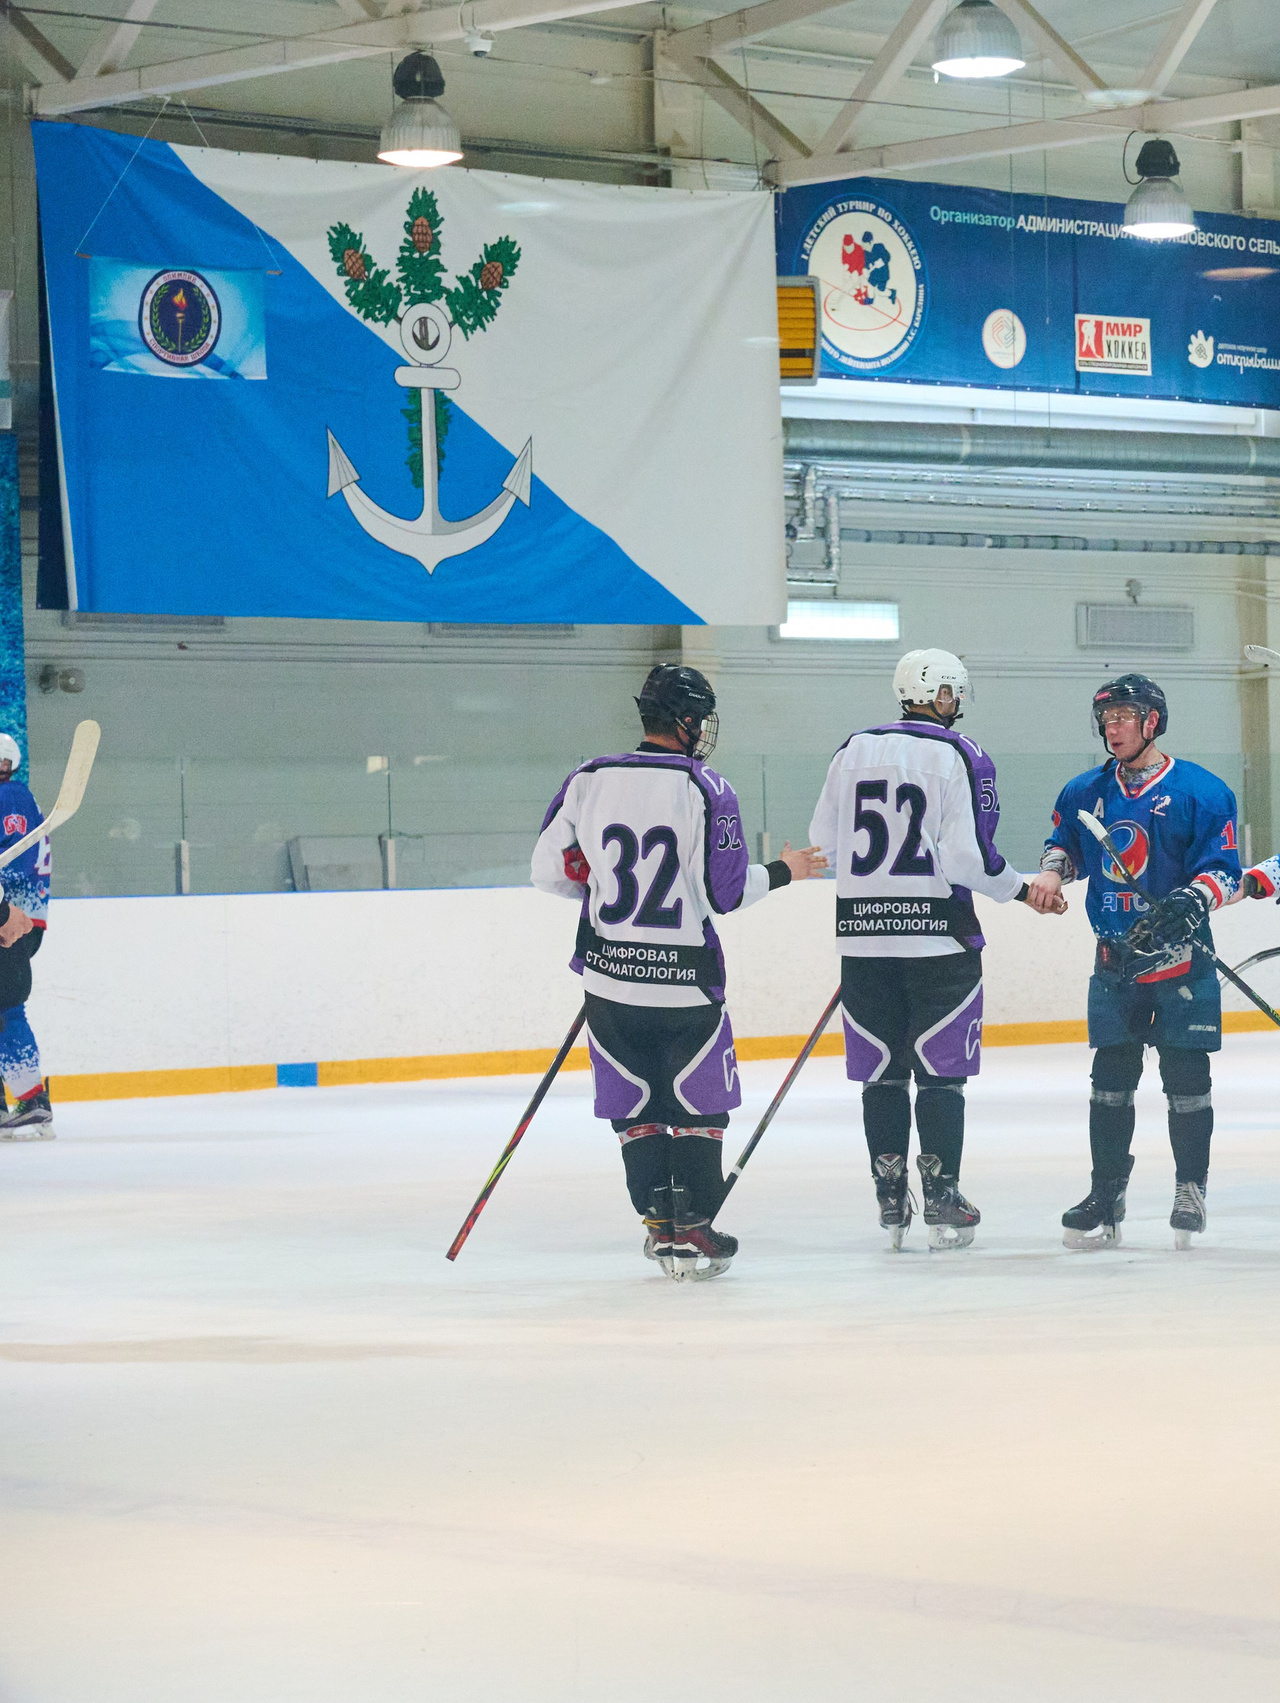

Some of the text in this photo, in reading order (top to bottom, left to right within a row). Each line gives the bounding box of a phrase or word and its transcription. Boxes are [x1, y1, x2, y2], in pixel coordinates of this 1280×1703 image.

[930, 205, 1015, 232] Организатор
[803, 206, 837, 250] ДЕТСКИЙ
[836, 200, 876, 212] ТУРНИР
[877, 206, 893, 222] ПО
[892, 220, 922, 270] ХОККЕЮ
[1105, 322, 1143, 337] МИР
[1106, 339, 1147, 360] ХОККЕЯ
[717, 815, 742, 850] 32
[850, 779, 935, 877] 52
[598, 823, 683, 929] 32
[853, 903, 931, 917] ЦИФРОВАЯ
[838, 919, 948, 931] СТОМАТОЛОГИЯ
[585, 950, 696, 981] СТОМАТОЛОГИЯ
[602, 943, 678, 963] ЦИФРОВАЯ
